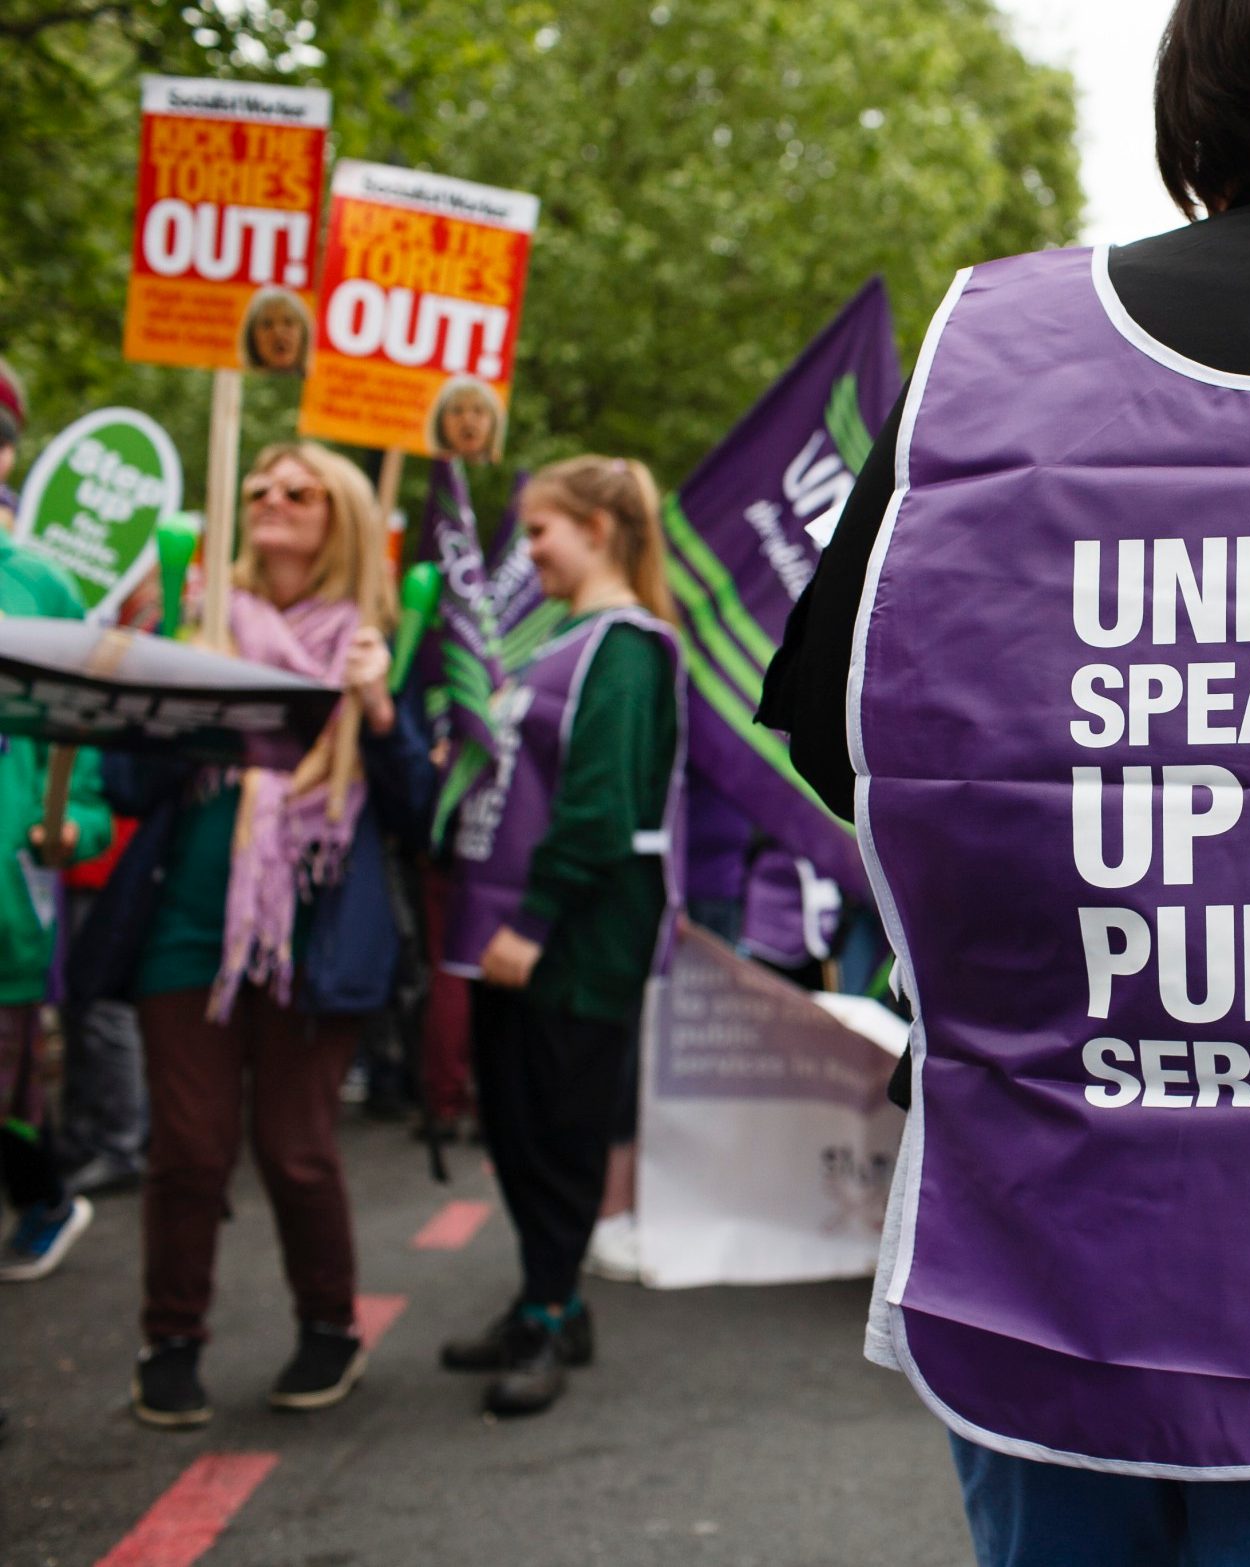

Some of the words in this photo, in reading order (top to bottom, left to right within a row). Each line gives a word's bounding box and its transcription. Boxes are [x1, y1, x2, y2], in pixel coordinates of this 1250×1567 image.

[154, 155, 312, 212] TORIES
[143, 198, 310, 287] OUT!
[345, 240, 511, 305] TORIES
[327, 279, 509, 379] OUT!
[1072, 764, 1244, 889] UP
